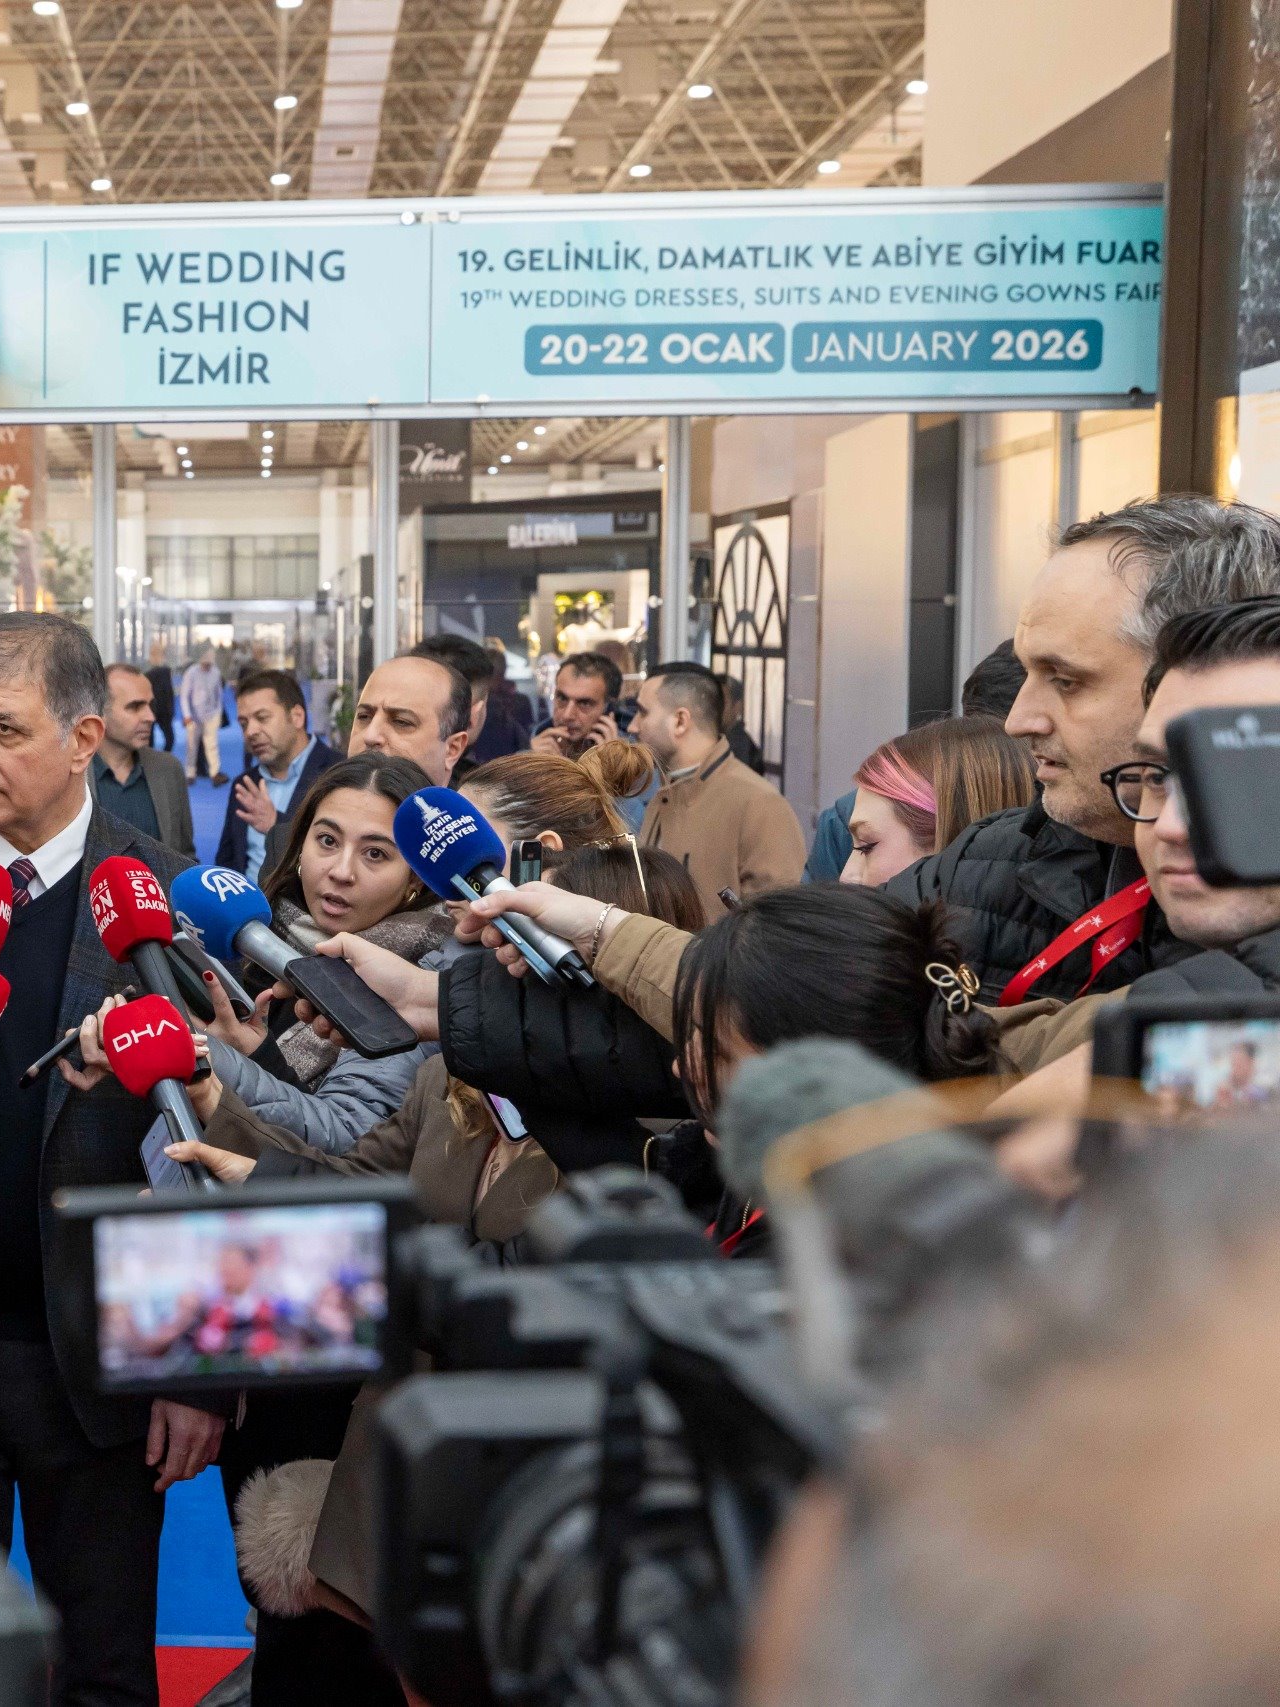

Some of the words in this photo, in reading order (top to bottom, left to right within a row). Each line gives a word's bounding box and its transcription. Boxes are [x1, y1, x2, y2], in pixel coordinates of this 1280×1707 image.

[88, 253, 121, 285] IF
[136, 249, 346, 285] WEDDING
[458, 250, 495, 273] 19.
[504, 240, 649, 274] GELİNLİK,
[658, 245, 813, 270] DAMATLIK
[823, 244, 862, 267] VE
[872, 236, 962, 268] ABİYE
[974, 234, 1064, 265] GİYİM
[461, 289, 502, 309] 19TH
[509, 289, 626, 308] WEDDING
[634, 287, 745, 309] DRESSES,
[754, 286, 821, 306] SUITS
[829, 285, 880, 305] AND
[889, 283, 998, 304] EVENING
[1006, 283, 1106, 302] GOWNS
[122, 299, 310, 334] FASHION
[539, 333, 649, 366] 20-22
[659, 332, 775, 364] OCAK
[804, 330, 978, 363] JANUARY
[991, 329, 1089, 362] 2026
[158, 346, 270, 385] İZMİR
[112, 1019, 180, 1053] DHA
